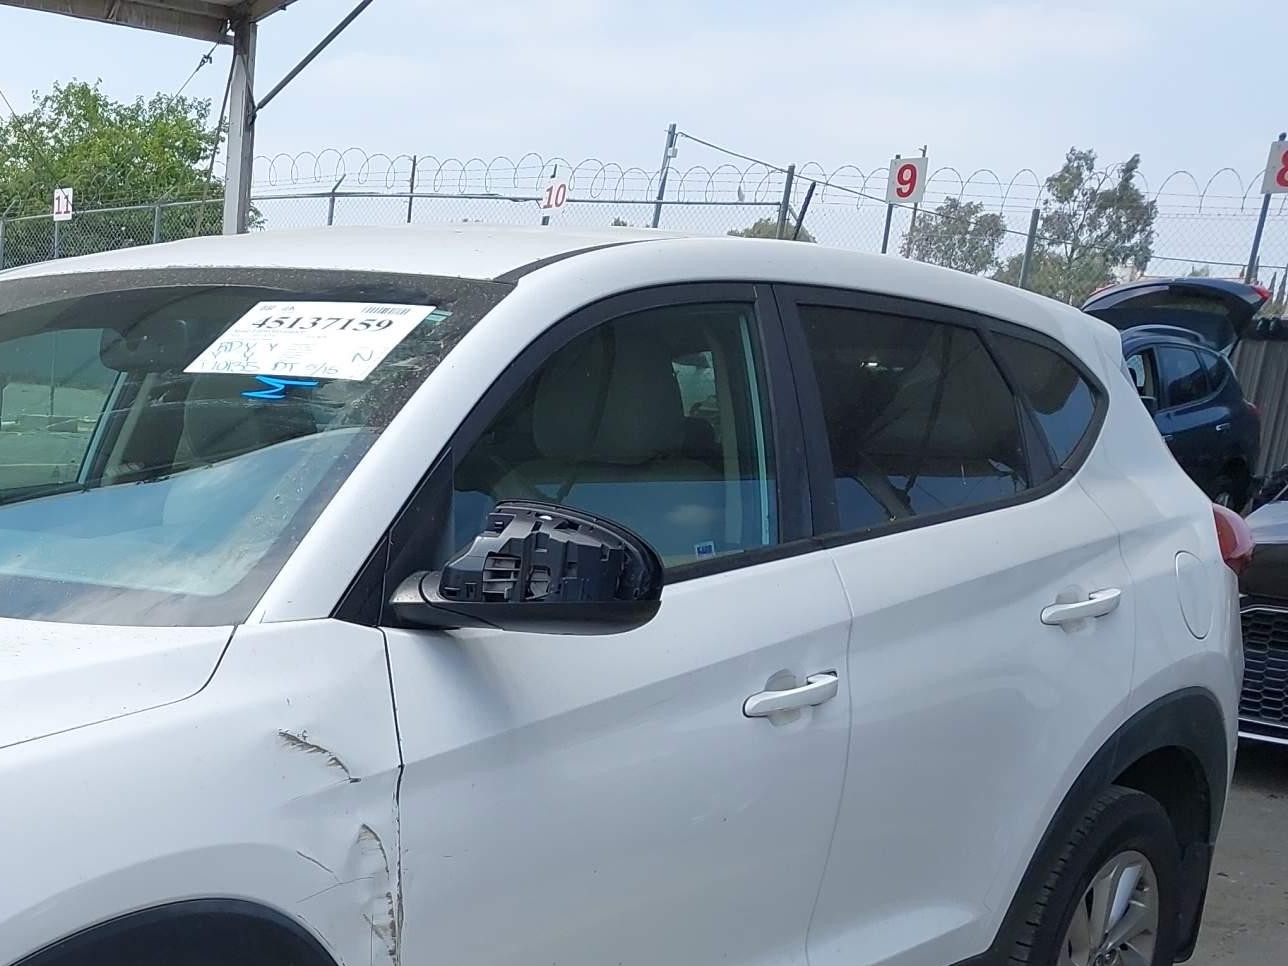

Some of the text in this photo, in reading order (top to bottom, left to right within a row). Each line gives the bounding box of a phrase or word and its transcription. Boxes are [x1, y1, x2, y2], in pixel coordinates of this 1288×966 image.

[897, 164, 917, 198] 9
[55, 195, 70, 215] 11
[542, 184, 567, 208] 10
[251, 316, 394, 332] 45137159
